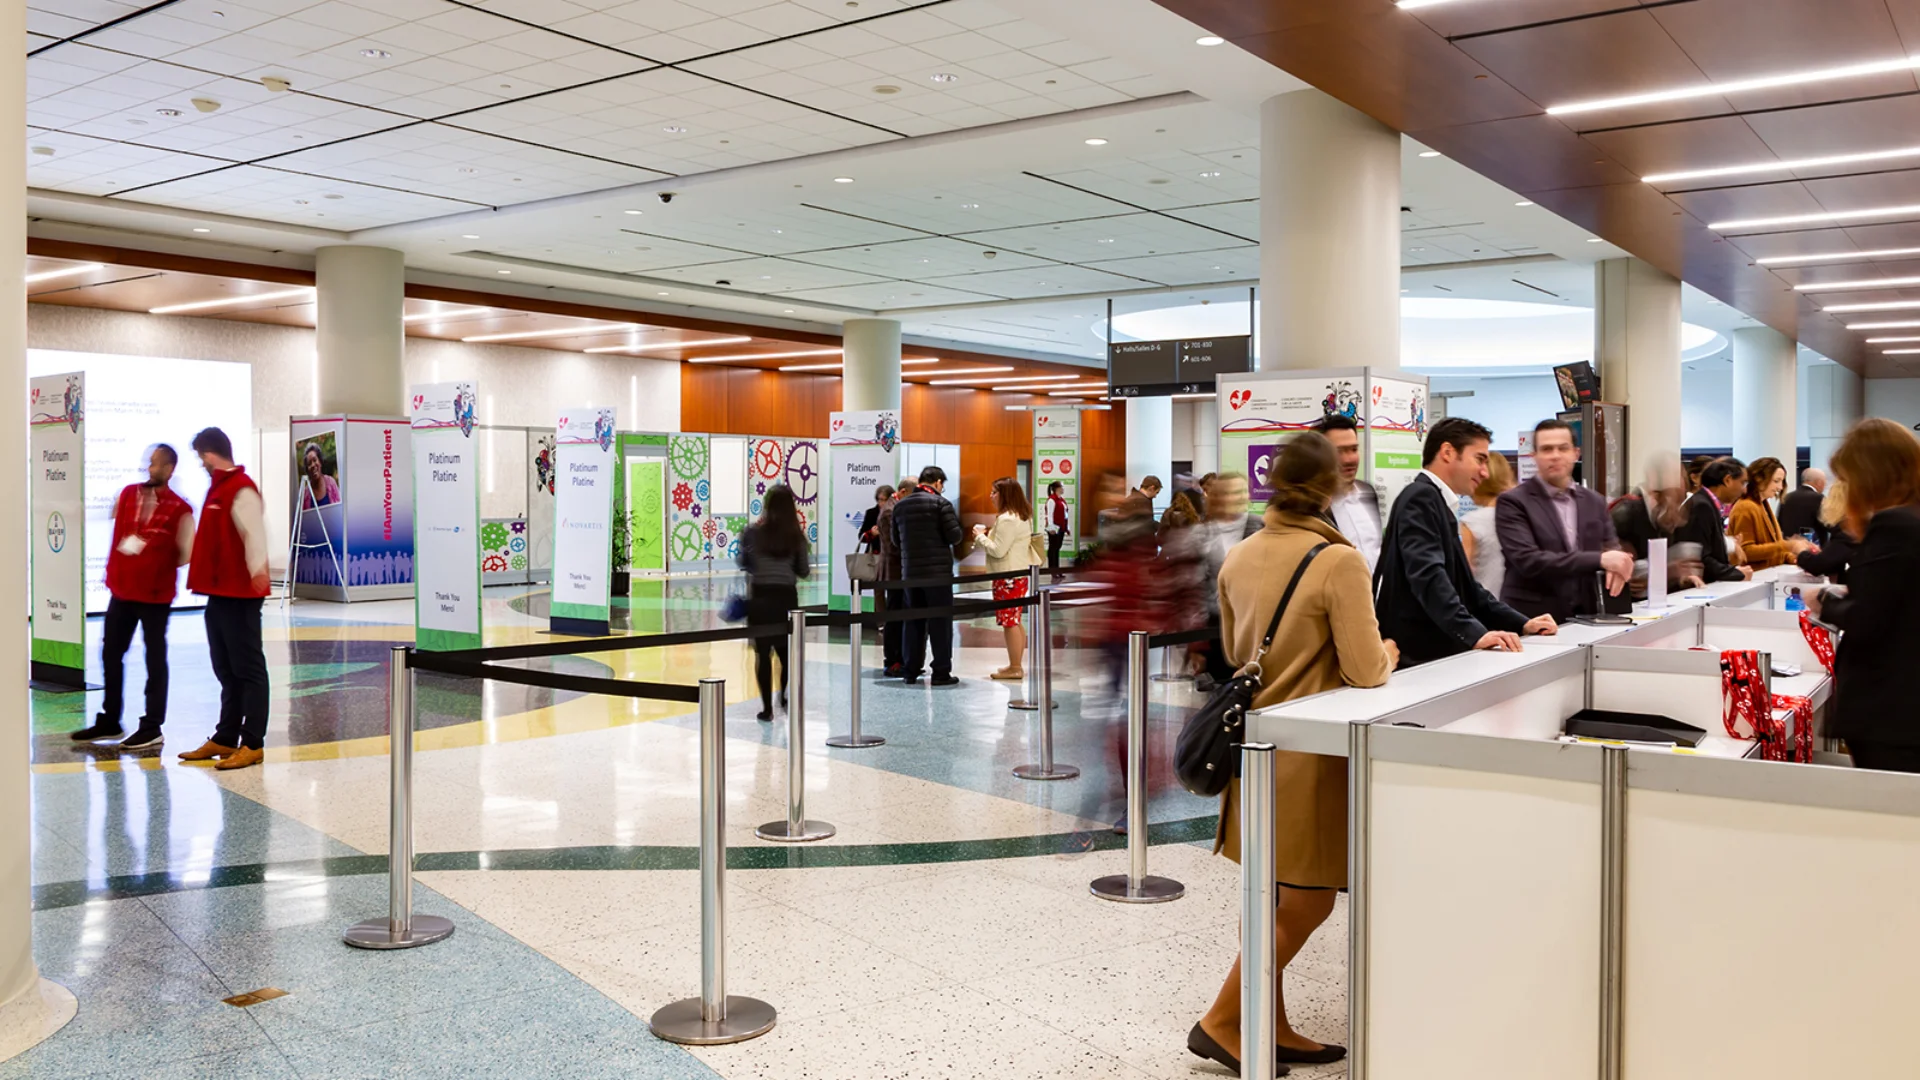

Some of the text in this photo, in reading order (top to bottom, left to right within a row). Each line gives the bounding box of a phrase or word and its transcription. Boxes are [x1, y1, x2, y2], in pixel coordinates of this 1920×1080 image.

[43, 449, 69, 462] Platinum
[429, 452, 461, 464] Platinum
[569, 462, 598, 472] Platinum
[847, 463, 881, 472] Platinum
[46, 468, 66, 481] Platine
[433, 470, 458, 482] Platine
[383, 429, 392, 541] #IAmYourPatient
[572, 476, 595, 486] Platine
[850, 476, 877, 486] Platine
[570, 522, 603, 530] NOVARTIS
[48, 528, 65, 536] BAYER
[435, 592, 460, 602] Thank You
[46, 599, 67, 610] Thank You
[440, 604, 455, 613] Merci
[51, 611, 62, 621] Merci
